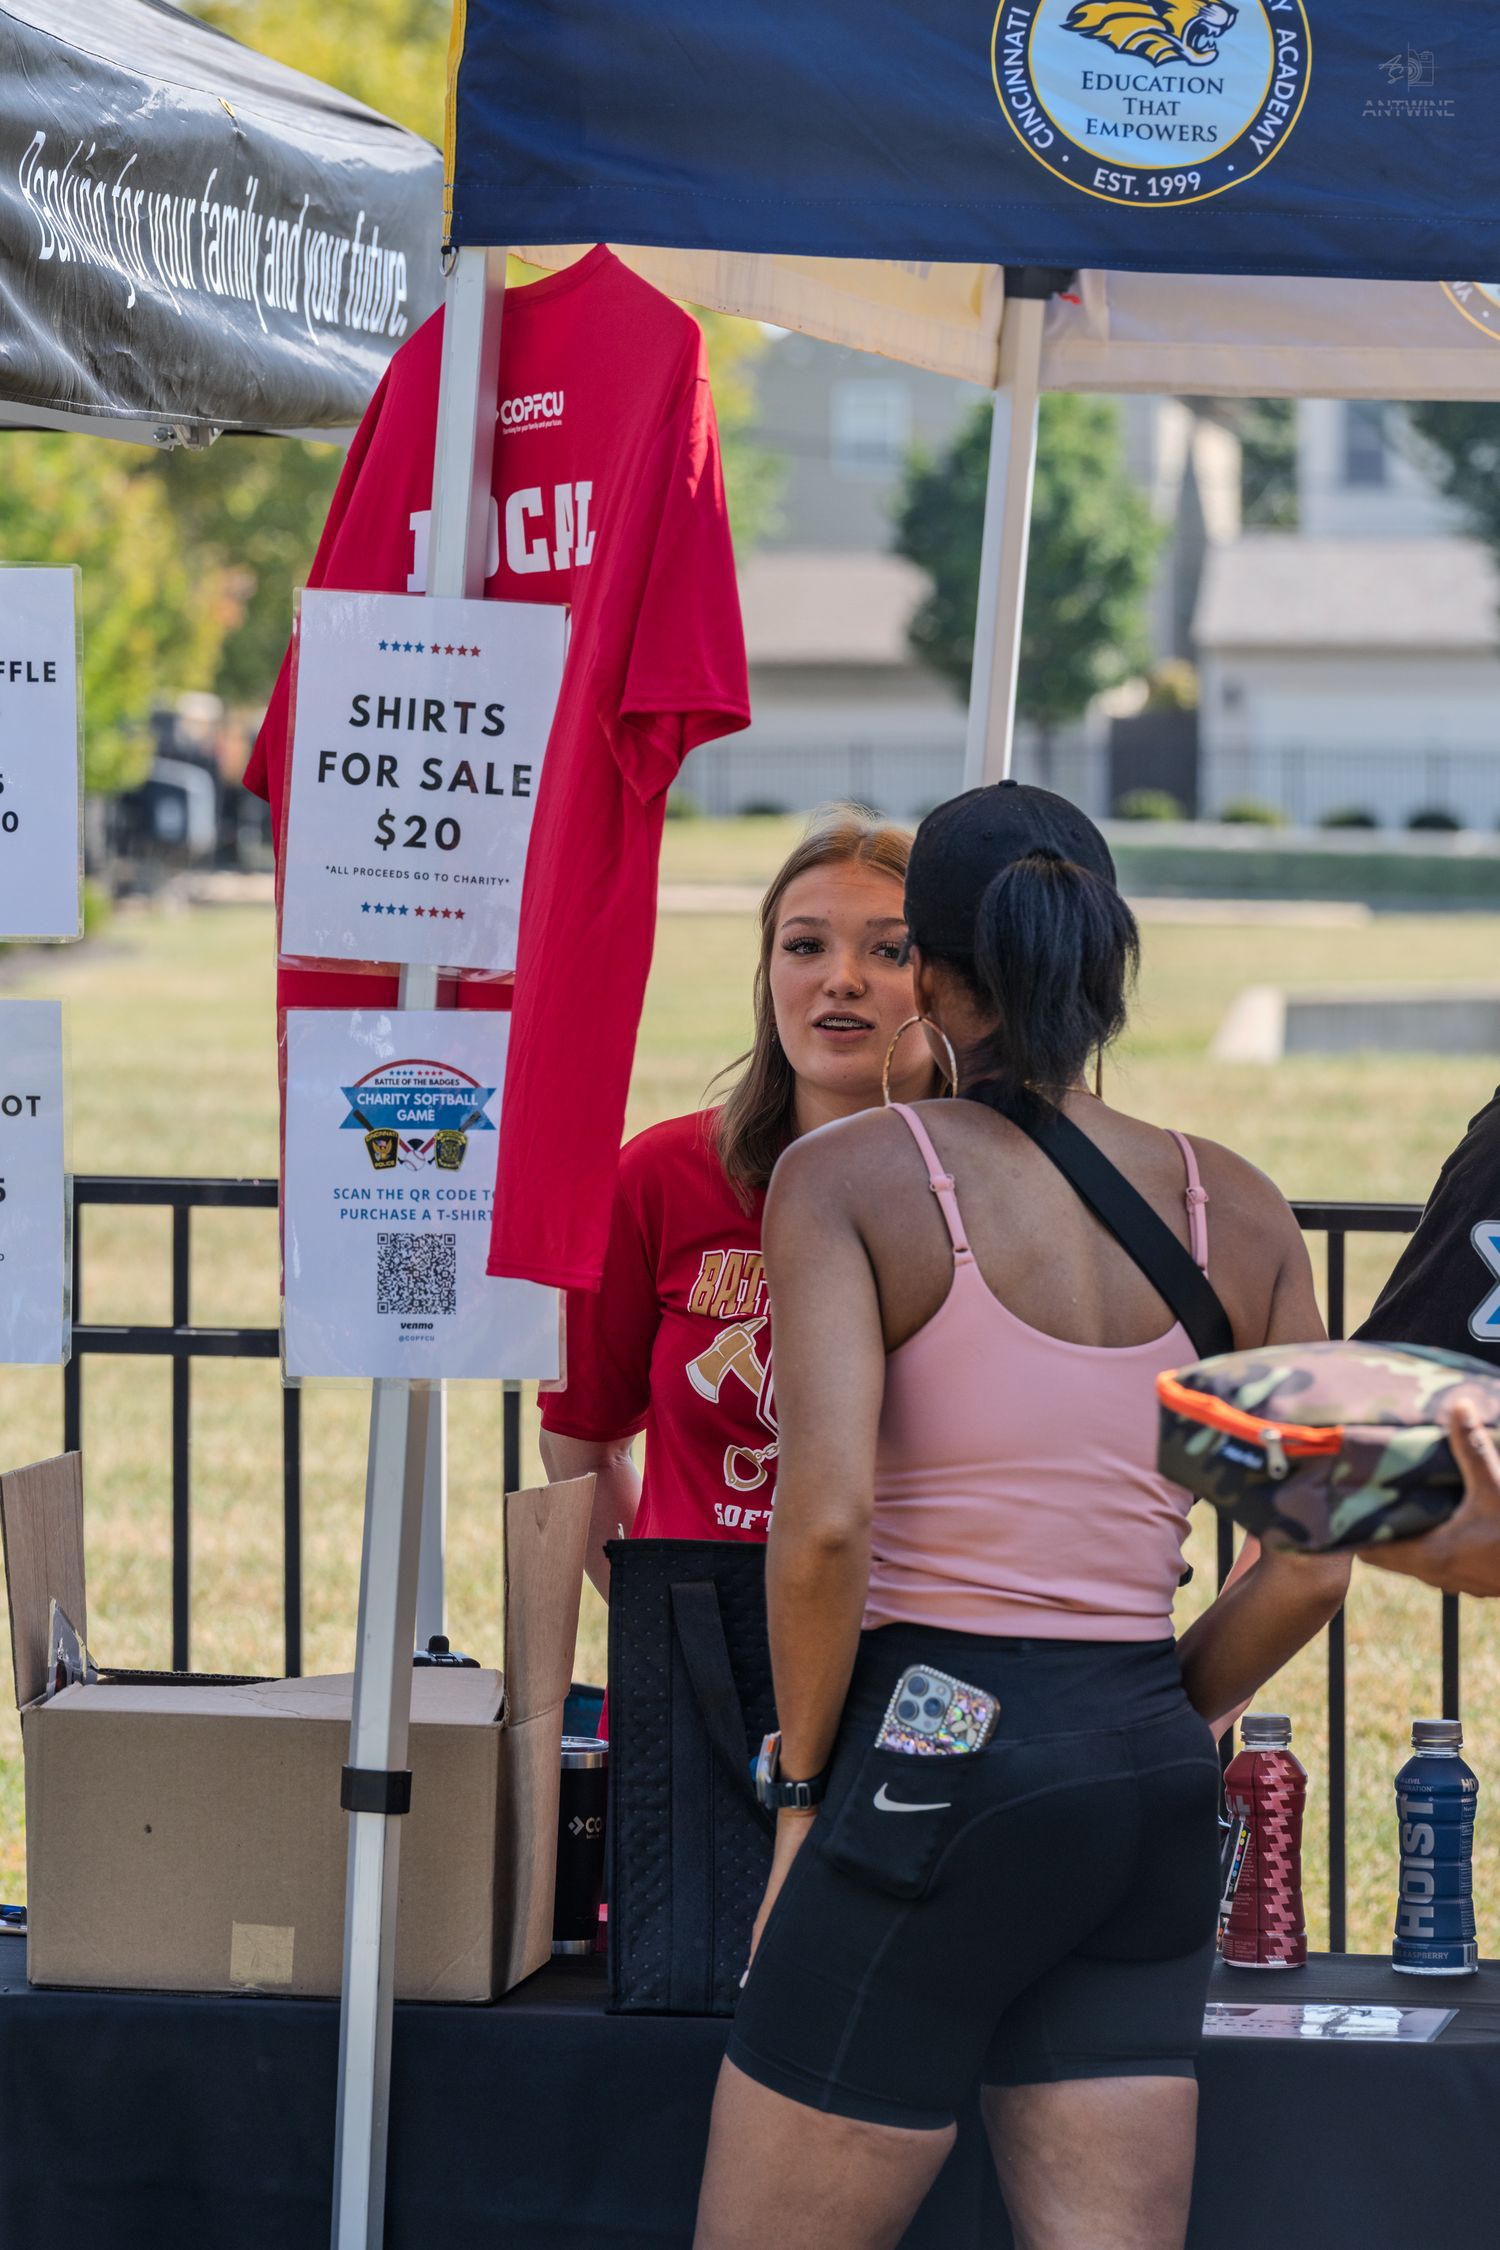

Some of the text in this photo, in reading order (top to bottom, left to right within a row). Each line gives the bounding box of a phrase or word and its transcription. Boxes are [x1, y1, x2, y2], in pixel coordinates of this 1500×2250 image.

[1003, 6, 1055, 149] CINCINNATI
[1081, 70, 1224, 95] EDUCATION
[1249, 28, 1299, 156] ACADEMY
[1123, 97, 1181, 117] THAT
[1085, 118, 1218, 143] EMPOWERS
[1093, 167, 1201, 197] EST. 1999
[19, 130, 136, 309] Banking
[112, 153, 153, 282] for
[148, 191, 198, 316] your
[200, 167, 268, 334] family
[263, 193, 309, 313] and
[303, 227, 350, 346] your
[500, 390, 564, 425] COPFCU
[348, 694, 505, 737] SHIRTS
[317, 750, 533, 798] FOR SALE
[374, 808, 461, 851] $20
[352, 866, 410, 880] PROCEEDS
[413, 872, 430, 881] GO
[434, 872, 449, 882] TO
[374, 1078, 461, 1086] BATTLE OF THE BADGES
[356, 1092, 479, 1106] CHARITY SOFTBALL
[396, 1108, 436, 1122] GAME
[333, 1188, 496, 1203] SCAN THE QR CODE T
[340, 1208, 417, 1220] PURCHASE
[422, 1209, 432, 1220] A
[688, 1248, 771, 1319] BAT
[400, 1322, 434, 1330] venmo
[1400, 1794, 1435, 1938] HOIST
